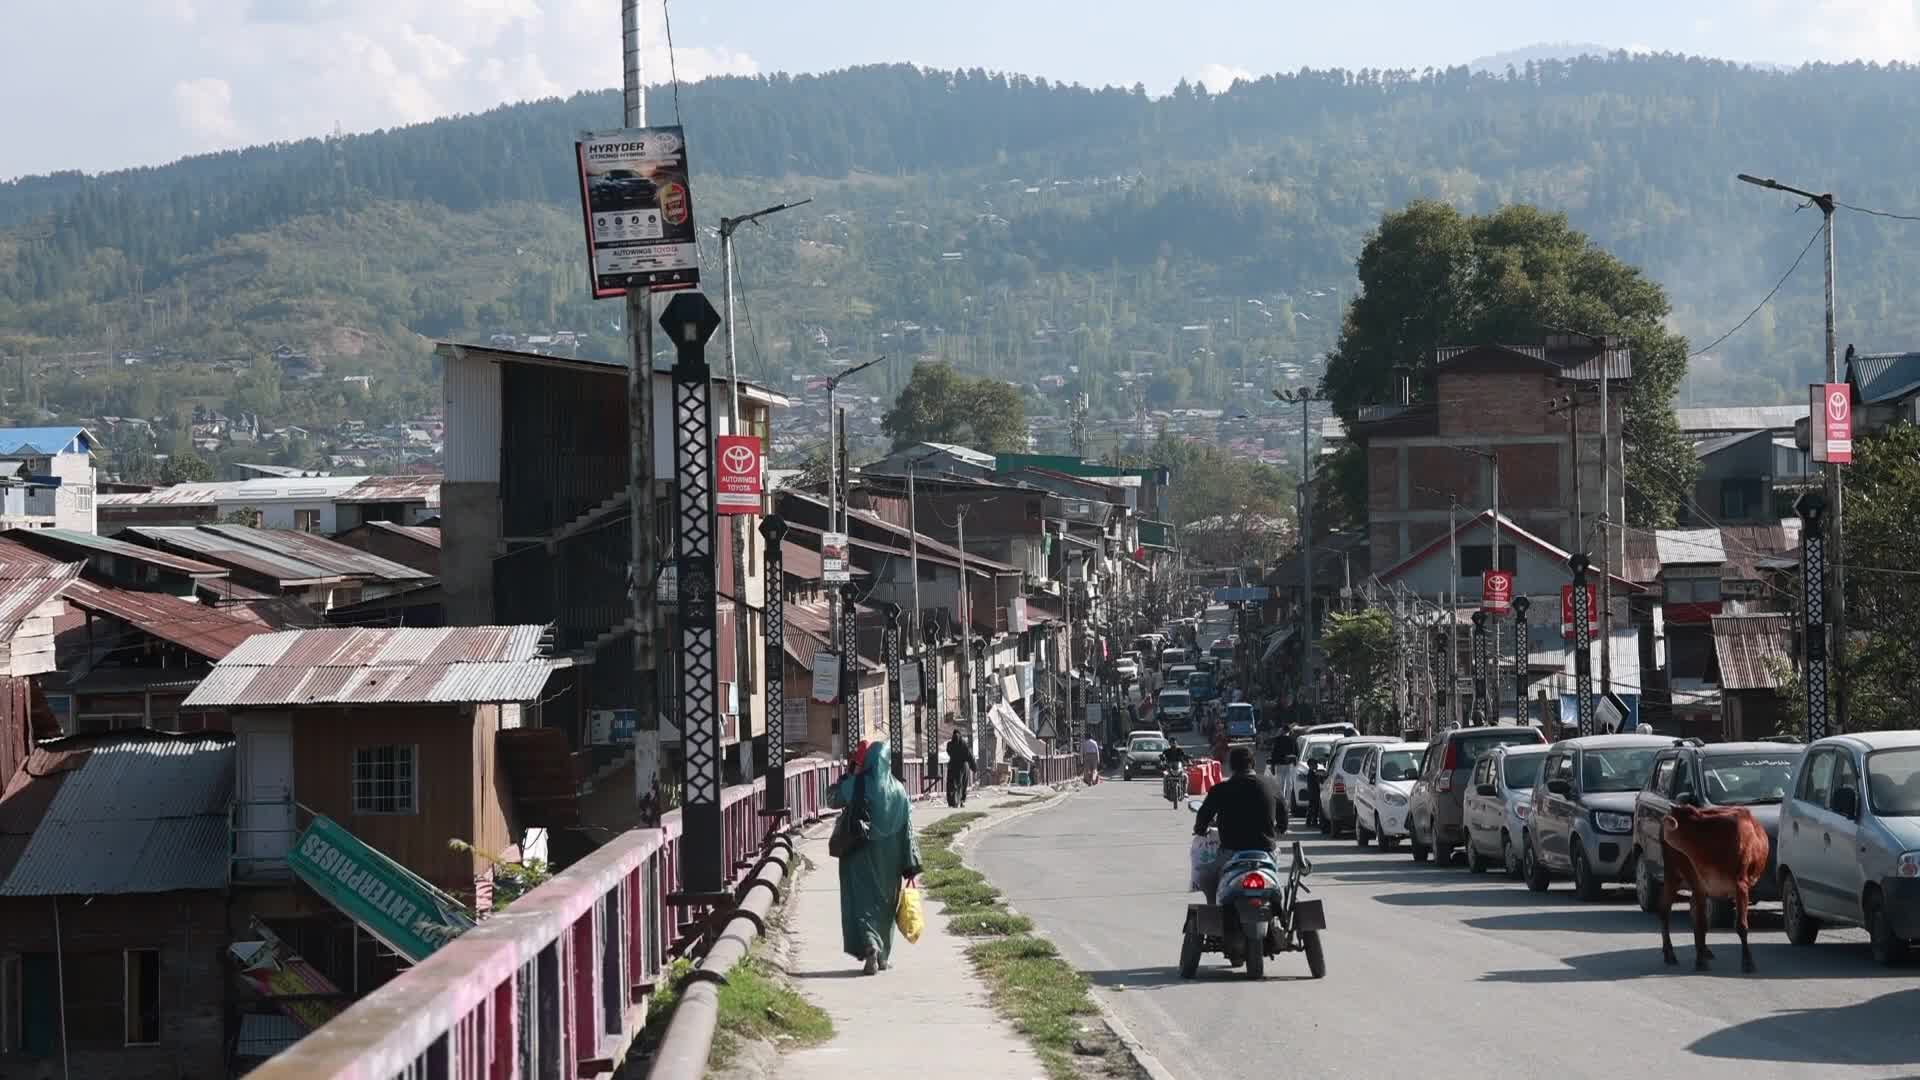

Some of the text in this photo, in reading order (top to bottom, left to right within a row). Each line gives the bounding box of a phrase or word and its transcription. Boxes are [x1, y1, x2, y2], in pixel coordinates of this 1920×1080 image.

[589, 142, 645, 153] HYRYDER
[613, 246, 678, 256] AUTOWINGS TOYOTA
[721, 475, 757, 484] AUTOWINGS
[727, 484, 752, 492] TOYOTA
[302, 834, 416, 926] ENTERPRISES
